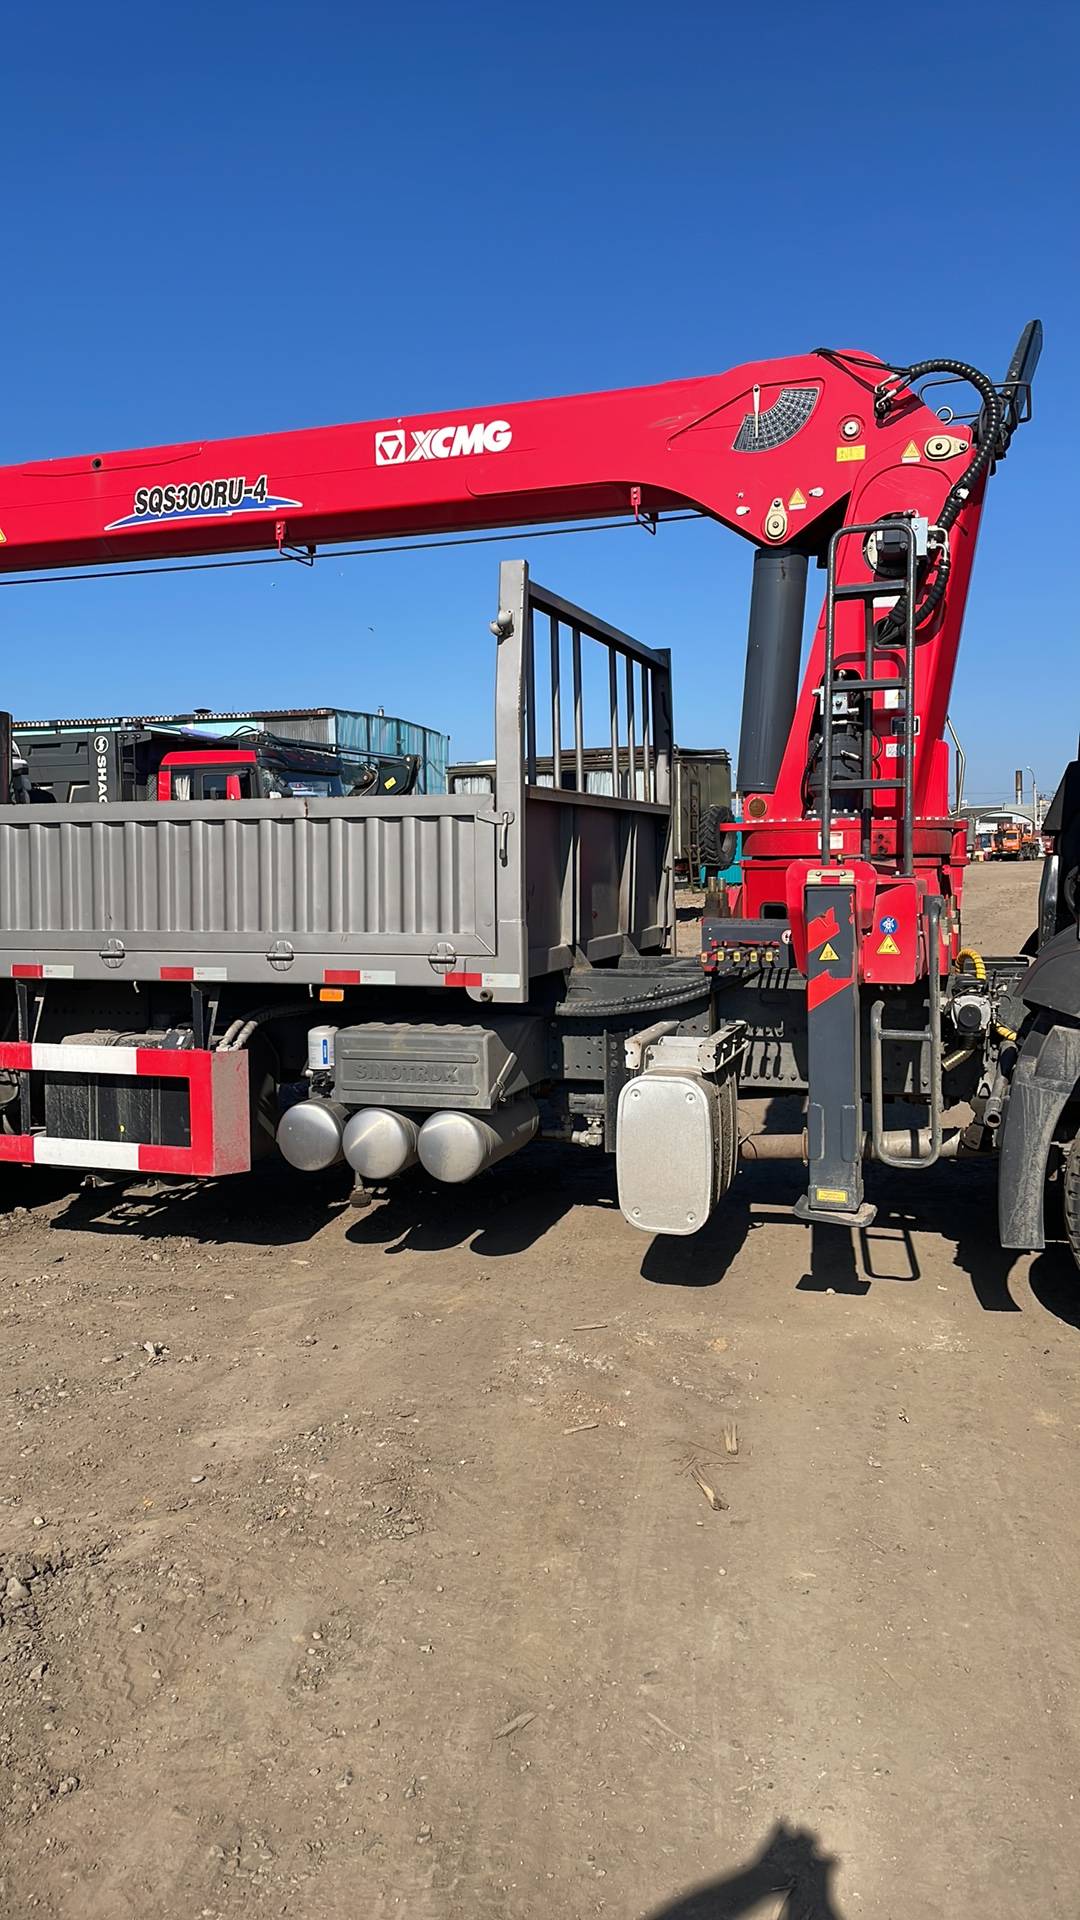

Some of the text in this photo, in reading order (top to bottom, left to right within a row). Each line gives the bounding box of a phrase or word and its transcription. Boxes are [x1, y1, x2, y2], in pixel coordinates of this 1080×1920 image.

[405, 420, 512, 462] XCMG
[135, 476, 267, 515] SQS300RU-4
[354, 1062, 460, 1083] SINOTRUK
